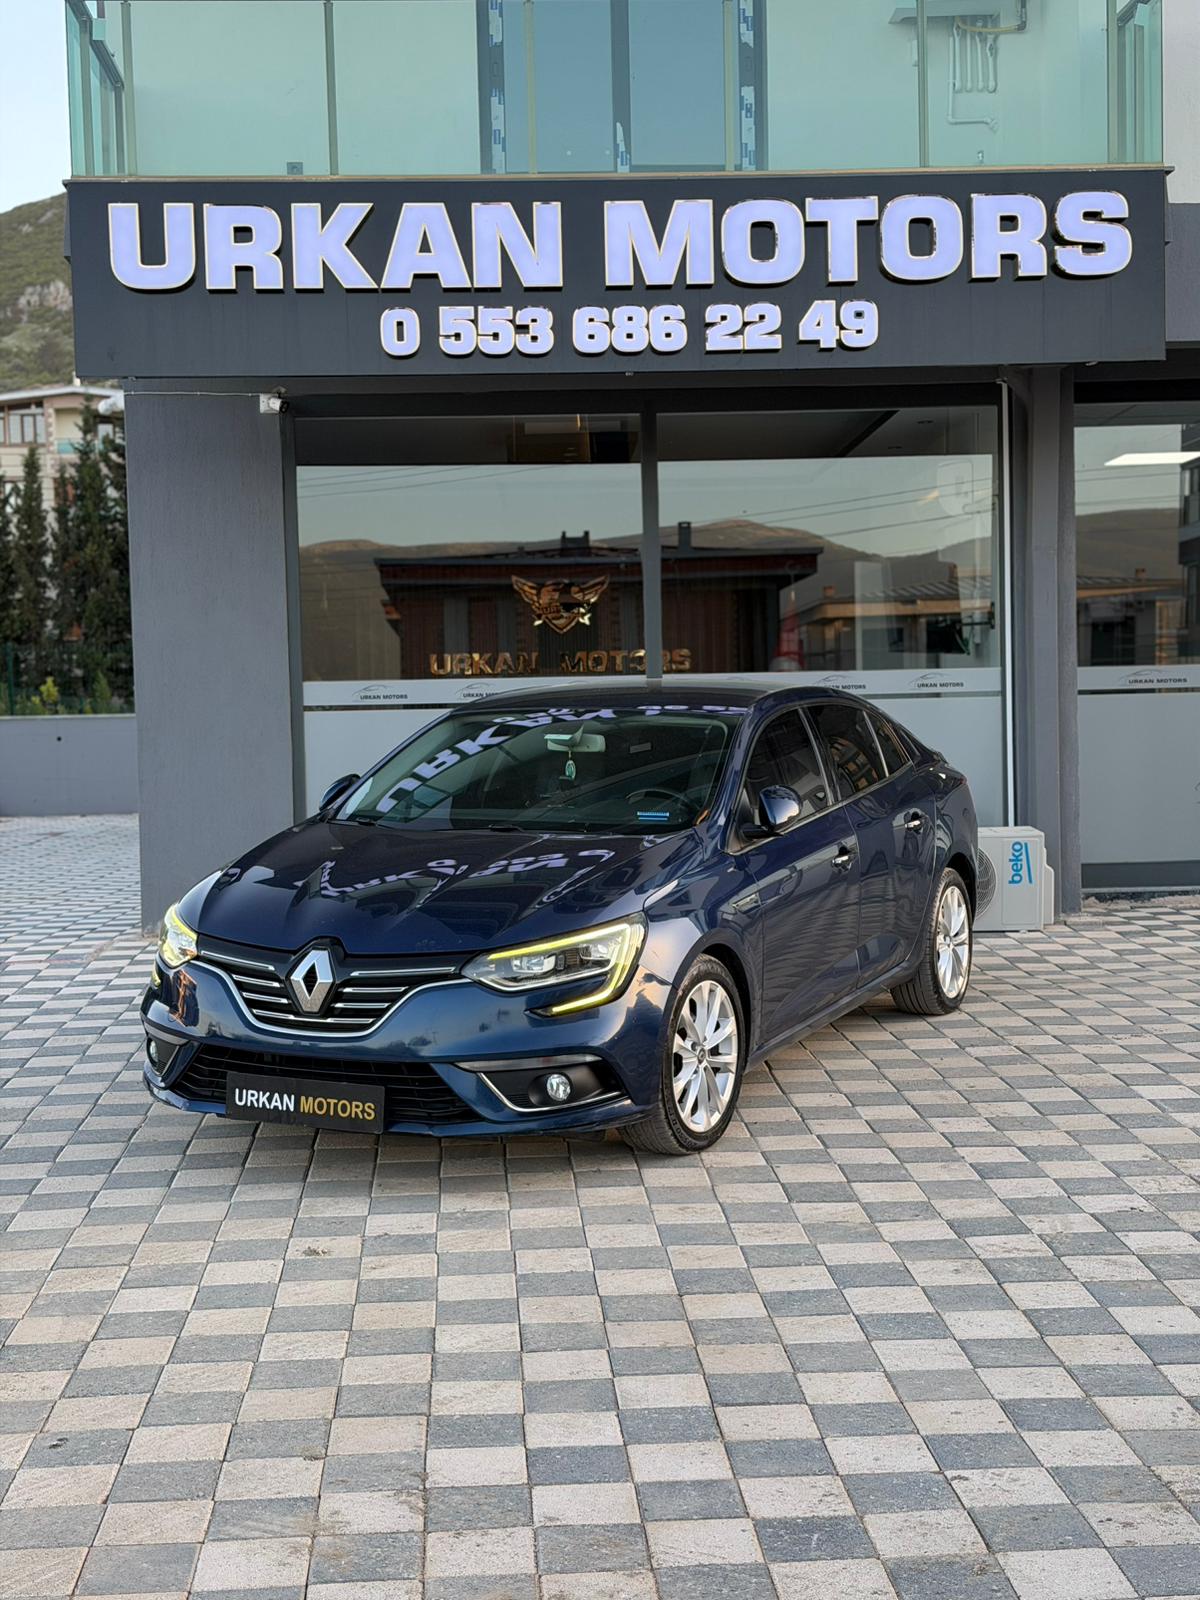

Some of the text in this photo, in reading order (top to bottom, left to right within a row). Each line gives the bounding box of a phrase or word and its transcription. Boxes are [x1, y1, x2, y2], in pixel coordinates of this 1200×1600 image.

[107, 190, 1133, 292] URKAN MOTORS
[379, 299, 879, 358] 0 553 686 22 49
[430, 654, 539, 676] URKAN
[1008, 841, 1023, 884] beko
[235, 1088, 375, 1121] URKAN MOTORS
